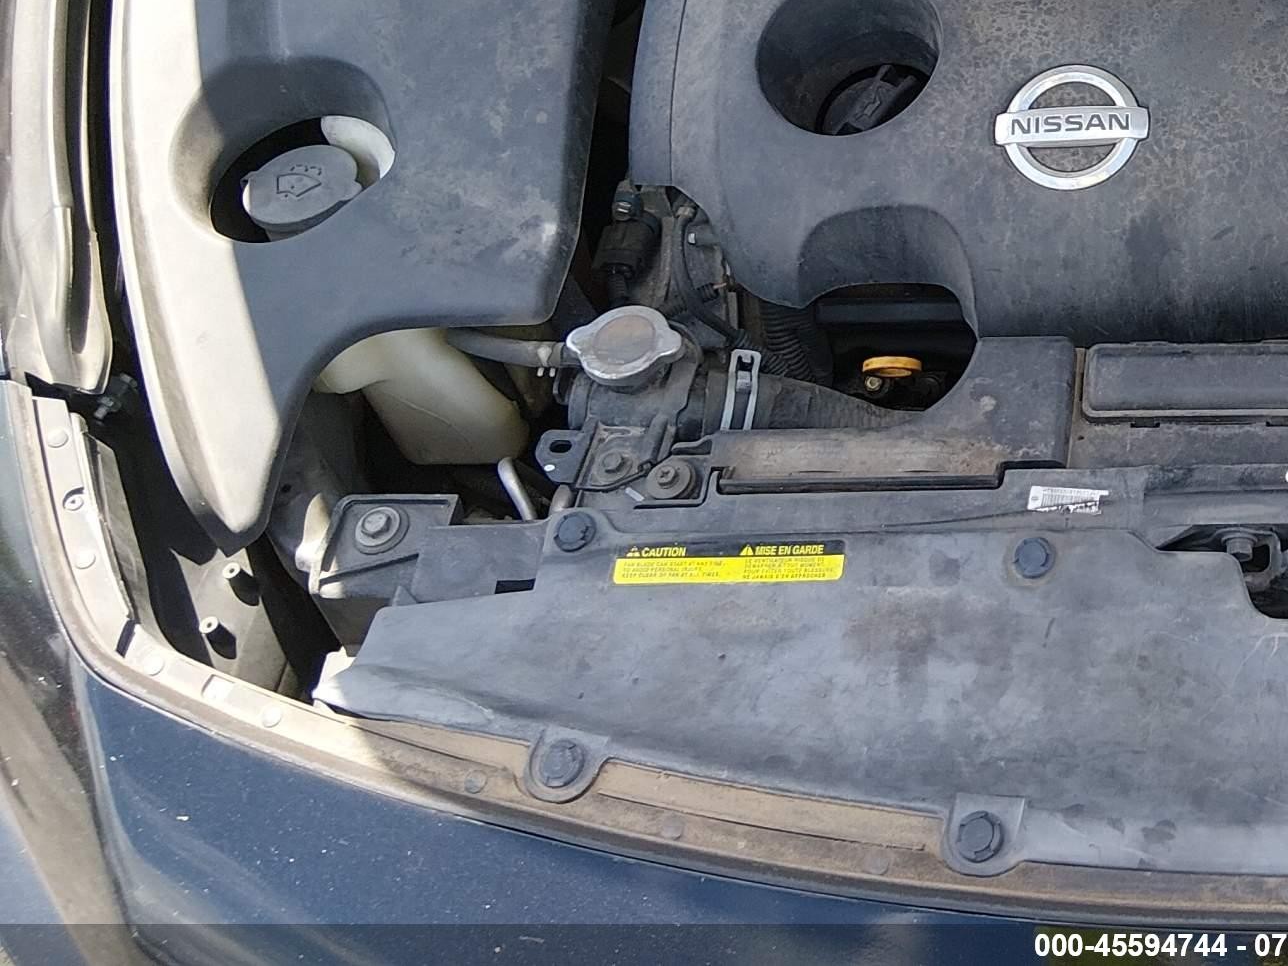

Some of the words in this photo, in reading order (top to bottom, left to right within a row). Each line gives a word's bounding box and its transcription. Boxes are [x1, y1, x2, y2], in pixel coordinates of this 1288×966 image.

[1010, 113, 1131, 136] NISSAN
[641, 546, 686, 557] CAUTION
[755, 545, 777, 555] MISE
[779, 545, 791, 555] EN
[792, 544, 825, 555] GARDE
